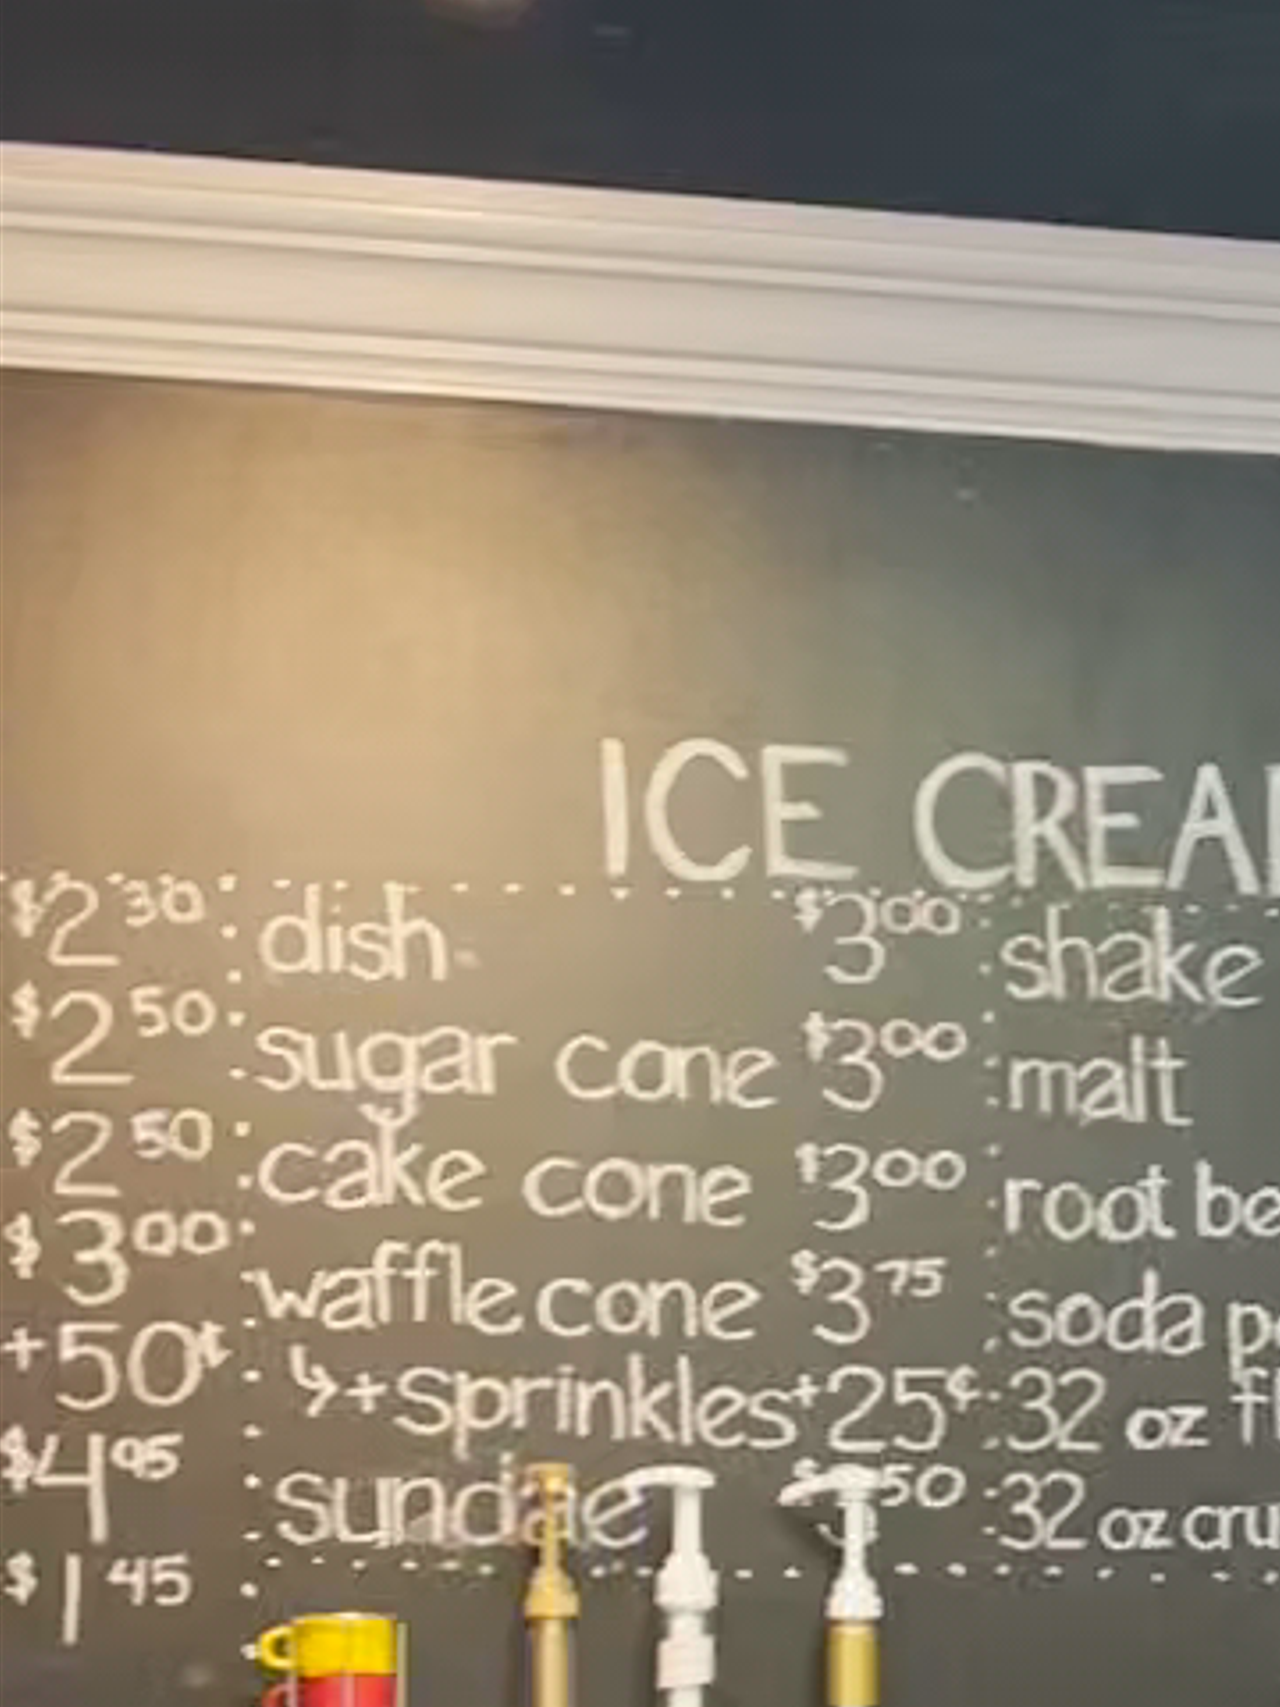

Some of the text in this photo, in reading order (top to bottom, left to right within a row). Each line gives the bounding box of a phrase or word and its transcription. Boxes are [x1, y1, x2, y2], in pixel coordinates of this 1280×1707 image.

[601, 736, 860, 881] ICE
[258, 883, 449, 981] dish
[1000, 905, 1264, 1009] shake
[254, 1024, 519, 1127] sugar
[555, 1033, 780, 1109] cone
[1007, 1035, 1193, 1127] malt
[258, 1111, 486, 1210] cake
[521, 1154, 753, 1229] cone
[1004, 1161, 1175, 1243] root
[256, 1241, 524, 1335] waffle
[536, 1276, 762, 1342] cone
[1008, 1270, 1204, 1353] soda
[1006, 1369, 1107, 1453] 32
[1126, 1407, 1207, 1448] oz
[1000, 1471, 1086, 1551] 32
[1098, 1506, 1171, 1551] oz
